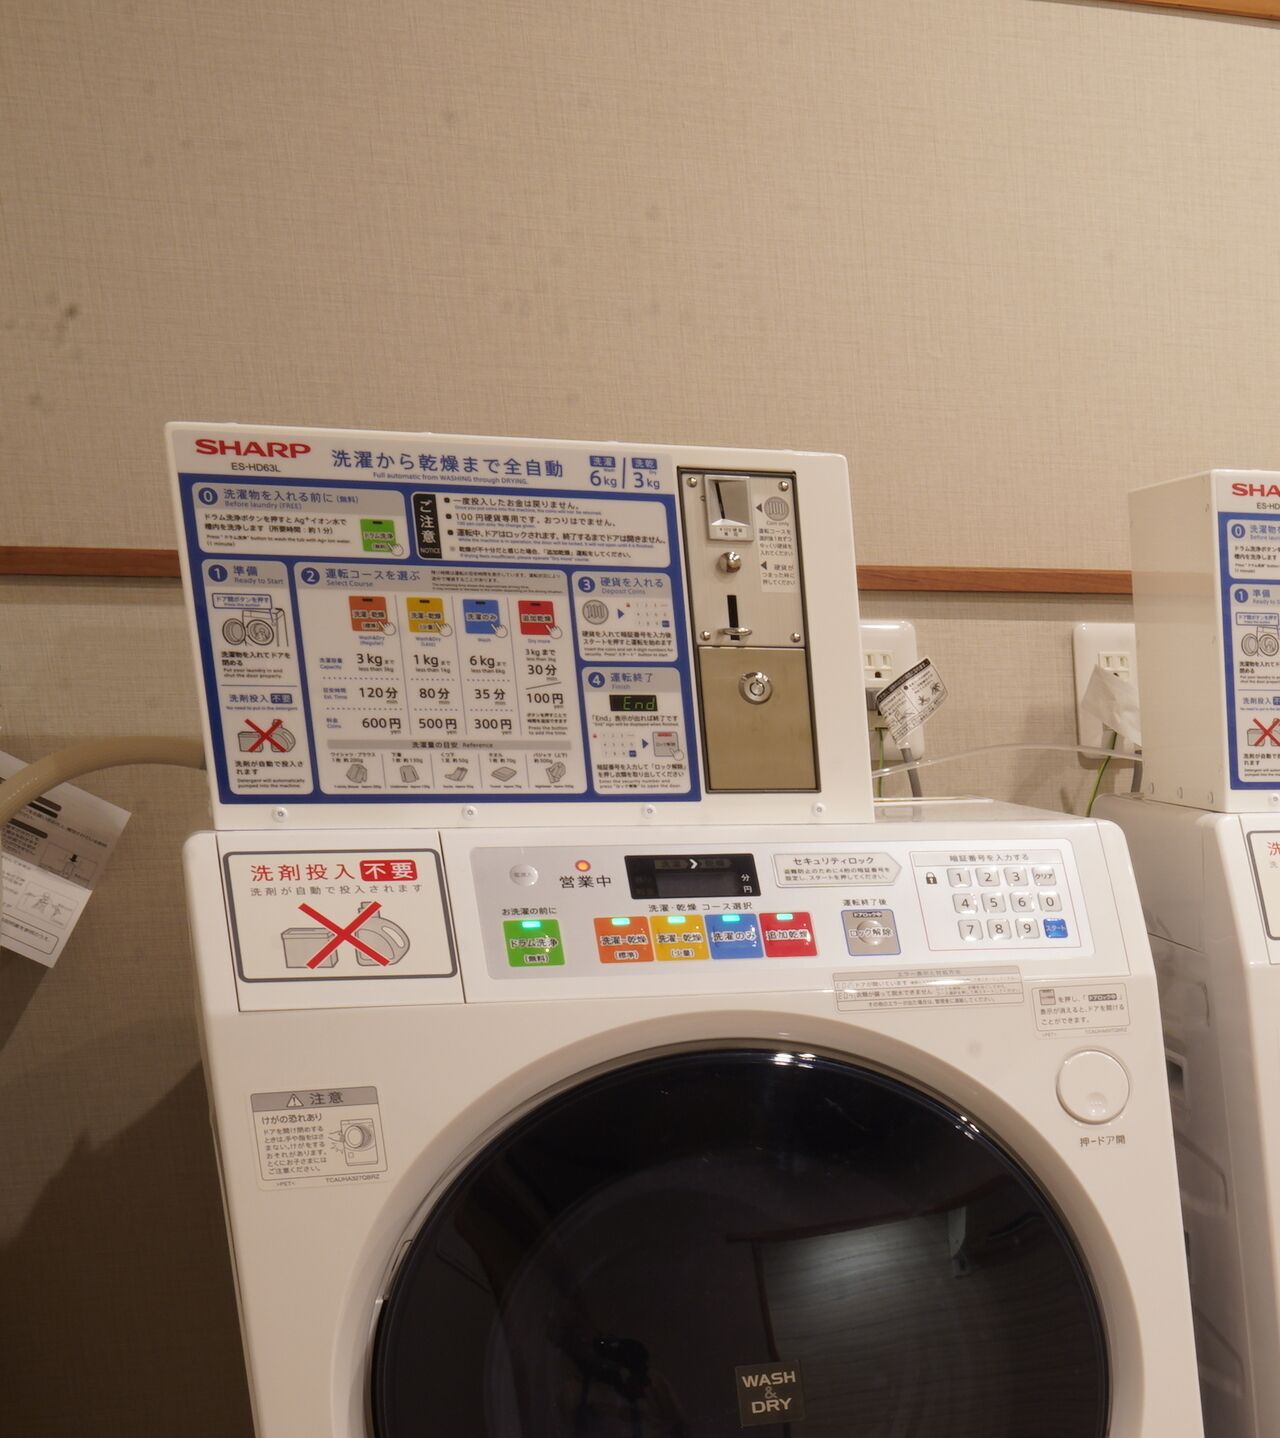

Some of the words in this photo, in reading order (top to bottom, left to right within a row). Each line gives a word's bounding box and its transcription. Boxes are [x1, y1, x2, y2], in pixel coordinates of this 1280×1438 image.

[195, 439, 311, 458] SHARP
[231, 462, 281, 472] ES-HD63L
[332, 449, 563, 478] 洗濯から乾燥まで全自動
[235, 577, 256, 585] Ready
[623, 696, 655, 710] End
[793, 857, 874, 865] セキュリティロック
[251, 864, 355, 881] 洗剤投入
[364, 862, 414, 880] 不要
[956, 873, 962, 882] 1
[984, 872, 992, 882] 2
[1013, 872, 1020, 881] 3
[559, 875, 612, 889] 営業中
[251, 884, 423, 897] 洗剤が自動で投入されます
[961, 899, 969, 908] 4
[990, 898, 998, 908] 5
[1018, 898, 1026, 907] 6
[1046, 897, 1054, 907] 0
[967, 925, 974, 935] 7
[995, 924, 1003, 934] 8
[1023, 923, 1031, 933] 9
[310, 1092, 343, 1105] 注意
[262, 1113, 322, 1124] けがの恐れあり
[742, 1371, 796, 1388] WASH
[765, 1386, 778, 1399] &
[752, 1398, 792, 1414] DRY
